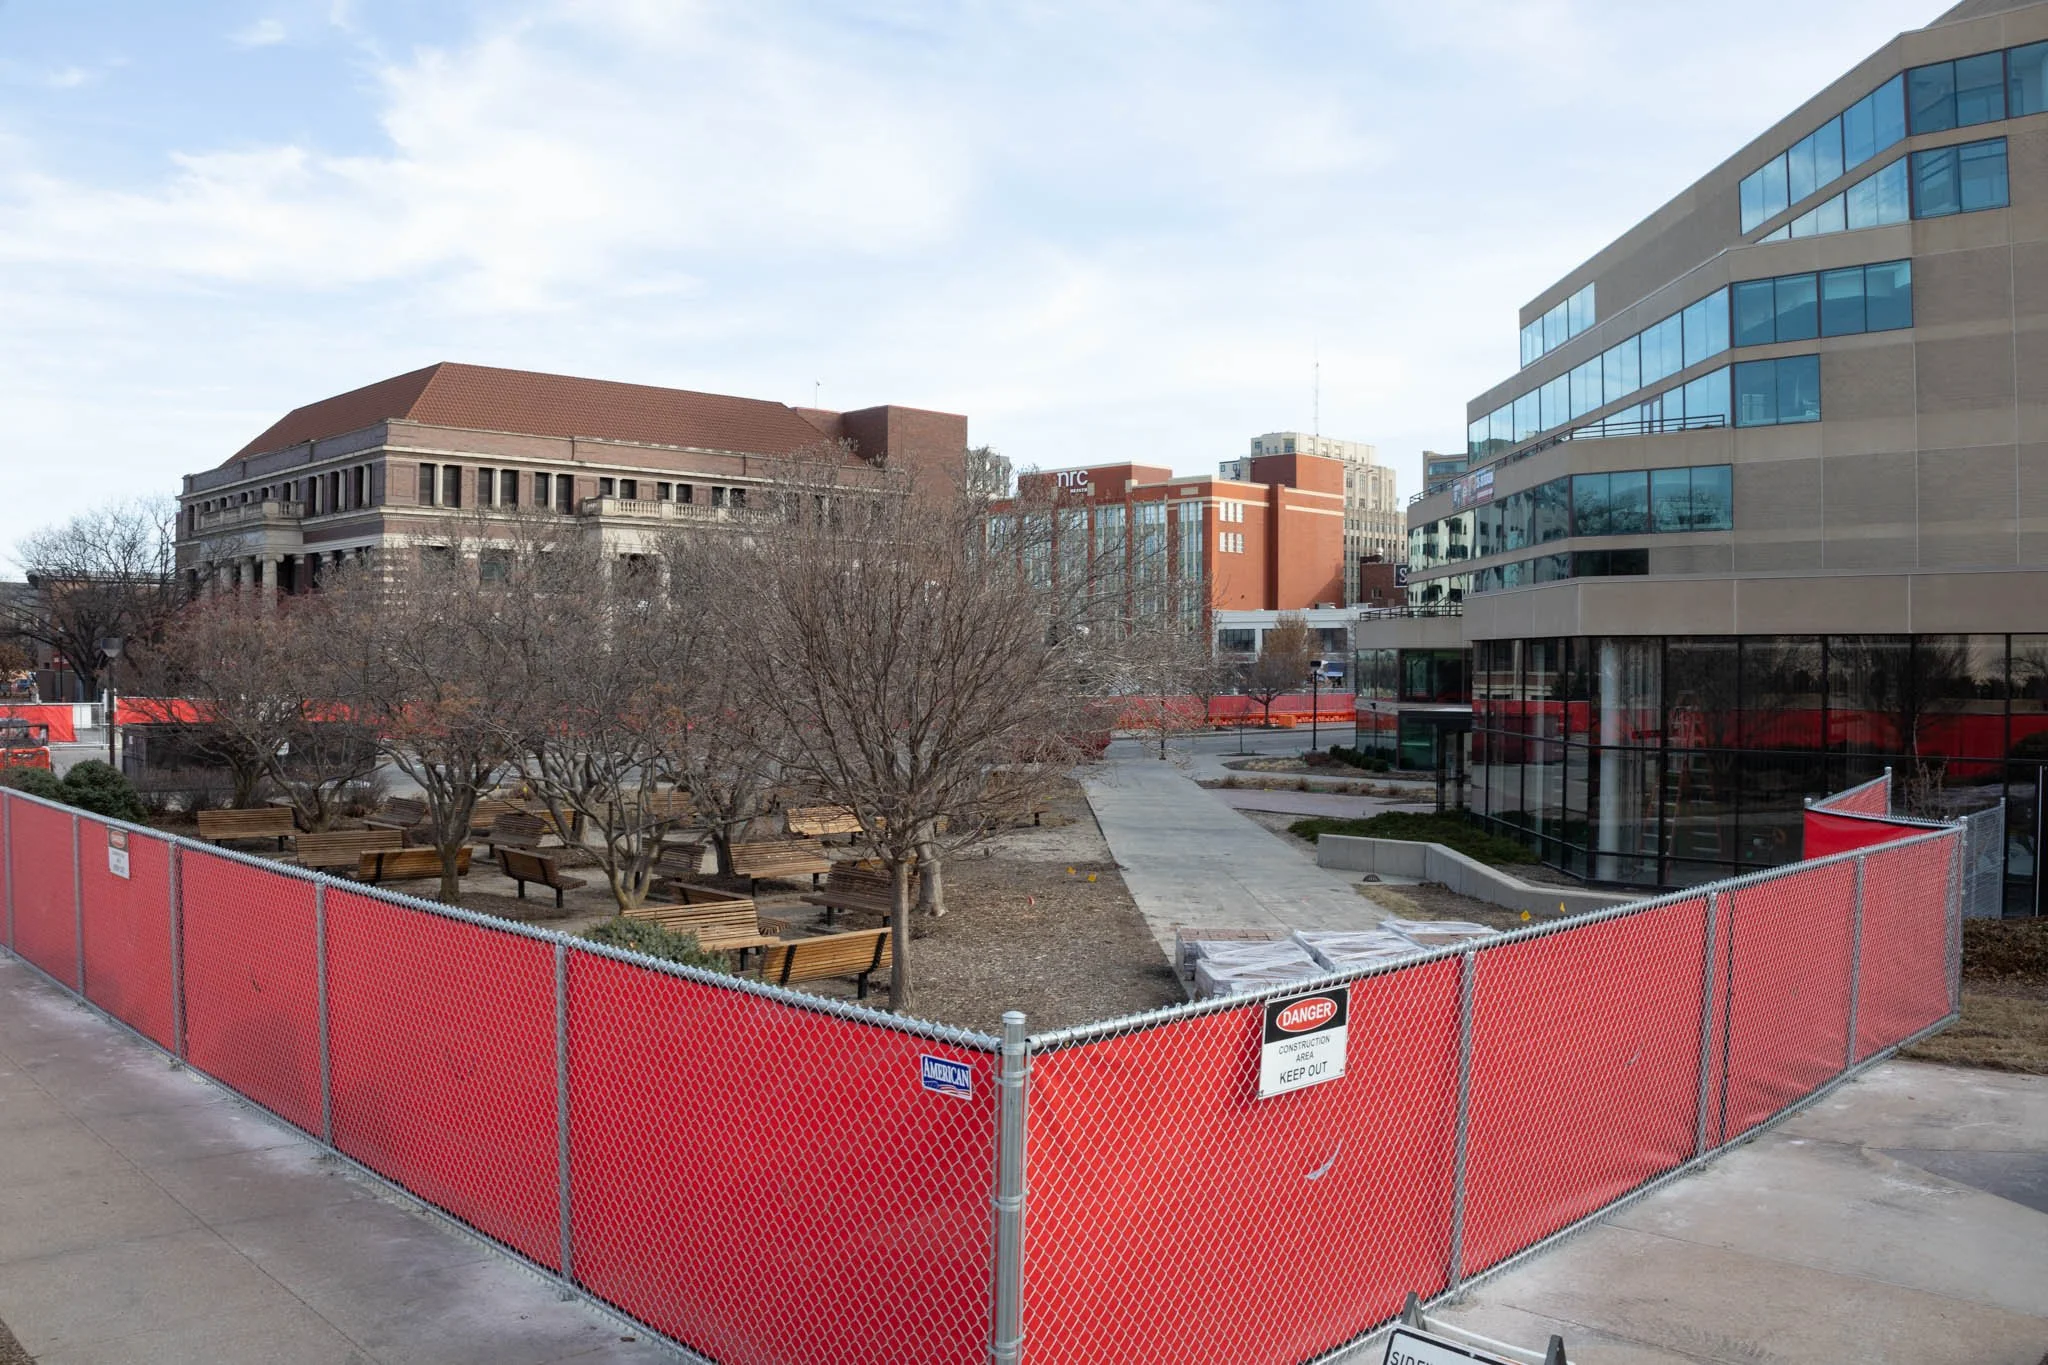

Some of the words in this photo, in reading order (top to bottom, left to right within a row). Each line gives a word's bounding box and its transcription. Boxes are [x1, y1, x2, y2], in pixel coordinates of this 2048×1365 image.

[1057, 470, 1088, 487] nrc
[1282, 1002, 1332, 1027] DANGER
[1278, 1035, 1330, 1055] CONSTRUCTION
[1296, 1050, 1314, 1063] AREA
[924, 1057, 970, 1088] AMERICAN
[1279, 1067, 1305, 1084] KEEP
[1308, 1061, 1328, 1077] OUT
[1390, 1351, 1432, 1365] SID
